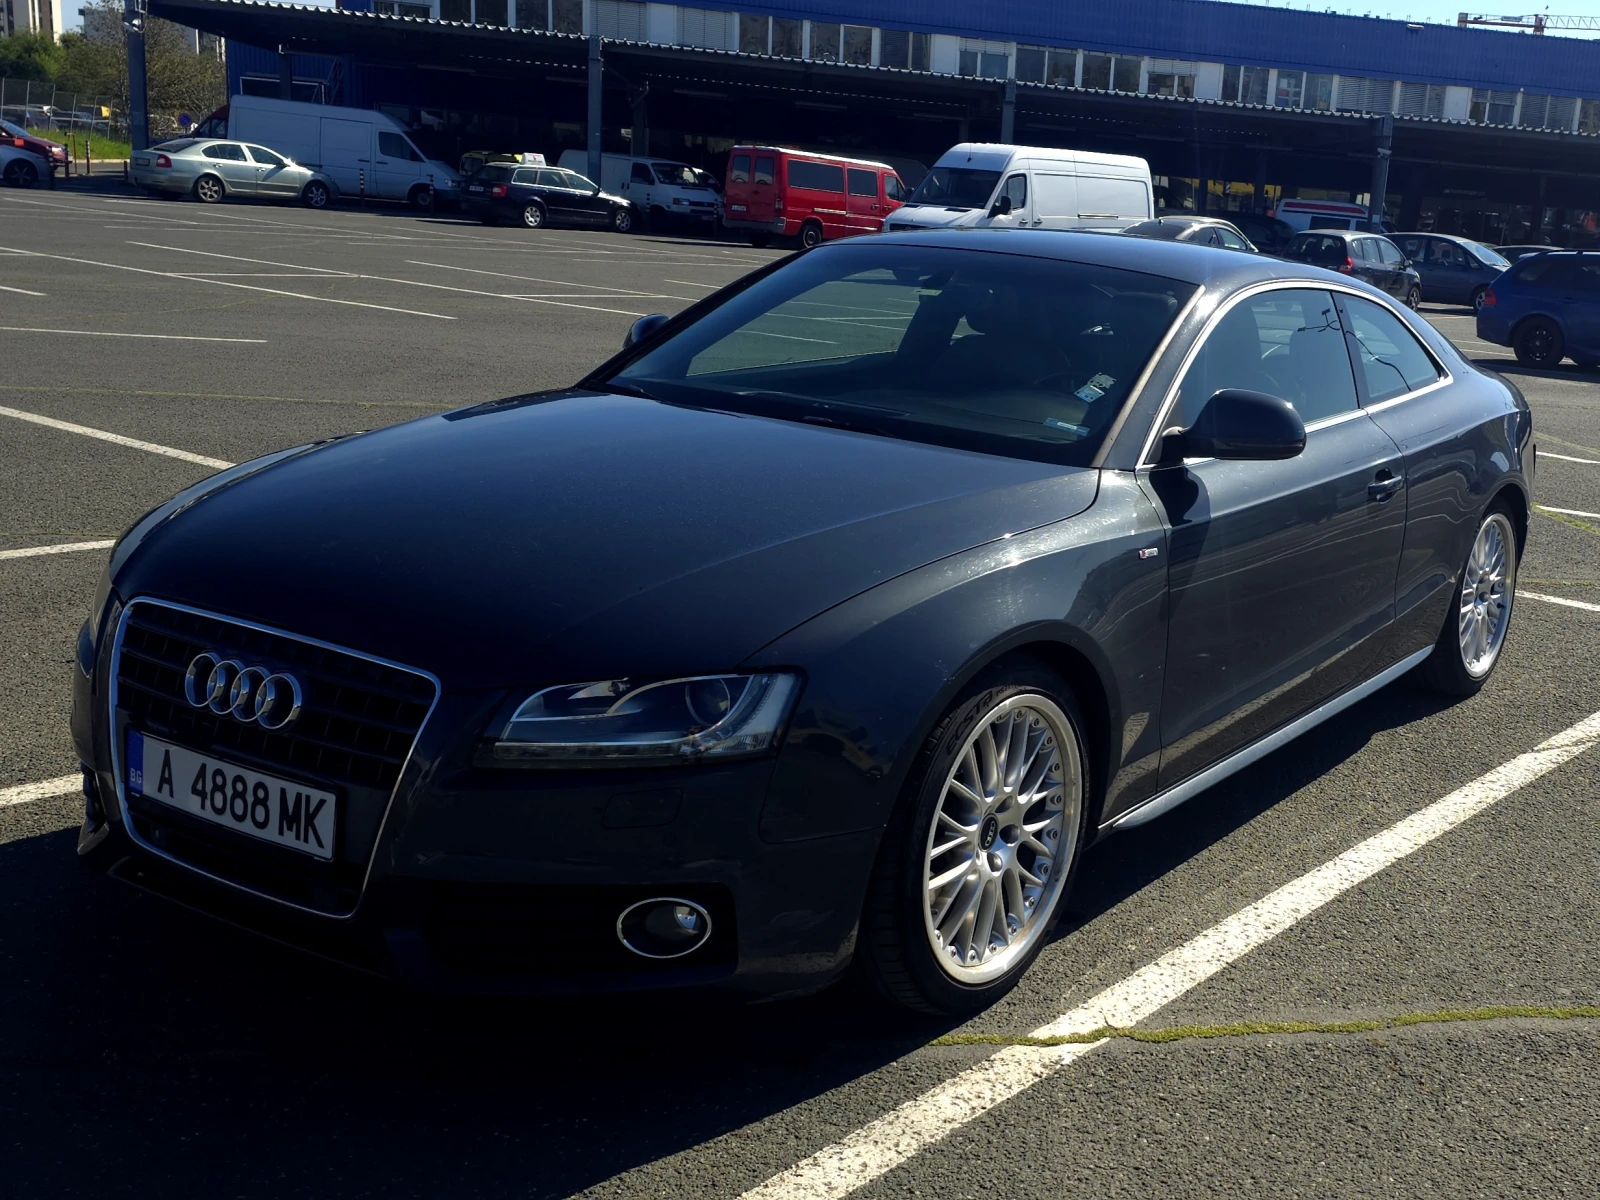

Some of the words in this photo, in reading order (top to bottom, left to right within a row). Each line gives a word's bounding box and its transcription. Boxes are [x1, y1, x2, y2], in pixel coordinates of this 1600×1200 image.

[946, 690, 993, 756] ECSTA
[129, 767, 142, 784] BG
[157, 748, 174, 798] A
[191, 762, 270, 830] 4888
[278, 787, 327, 849] MK
